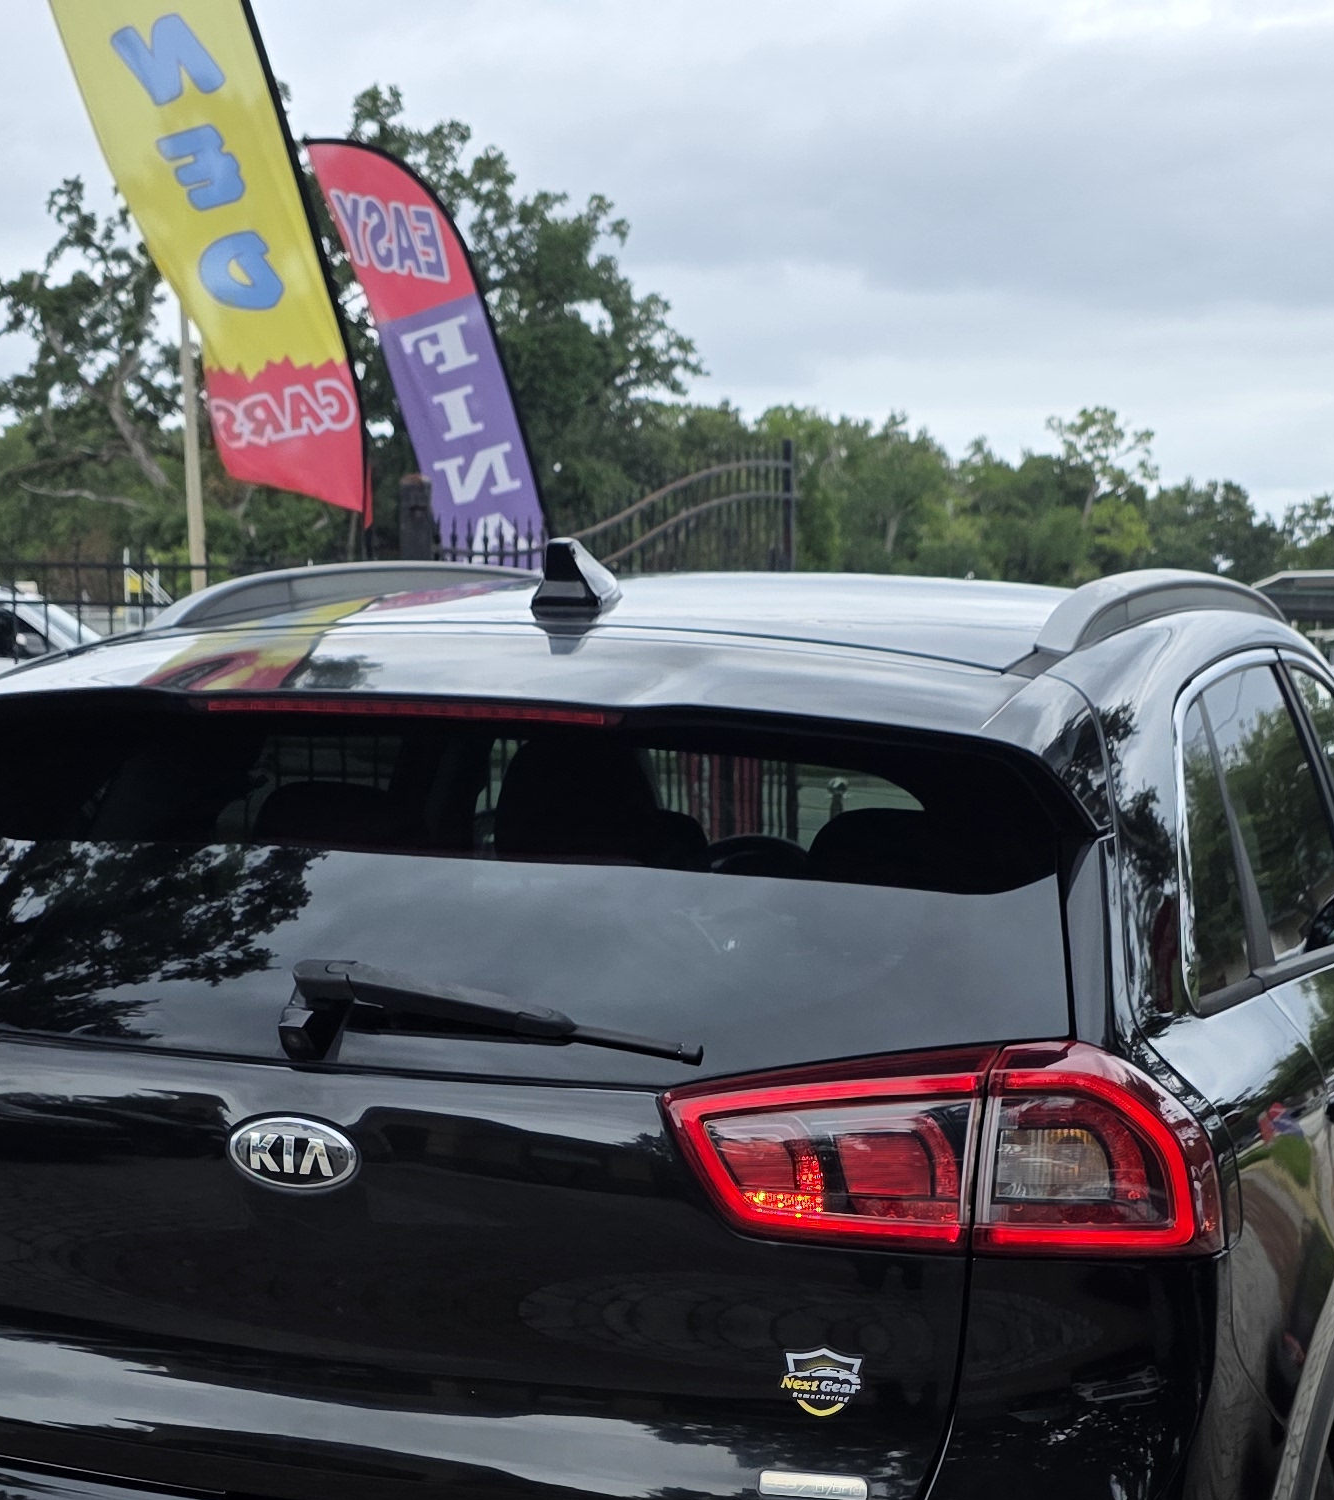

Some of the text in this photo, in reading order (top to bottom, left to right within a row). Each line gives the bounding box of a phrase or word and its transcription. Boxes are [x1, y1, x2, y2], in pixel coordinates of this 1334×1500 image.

[249, 1134, 334, 1177] KIA
[780, 1375, 862, 1395] Next Gear
